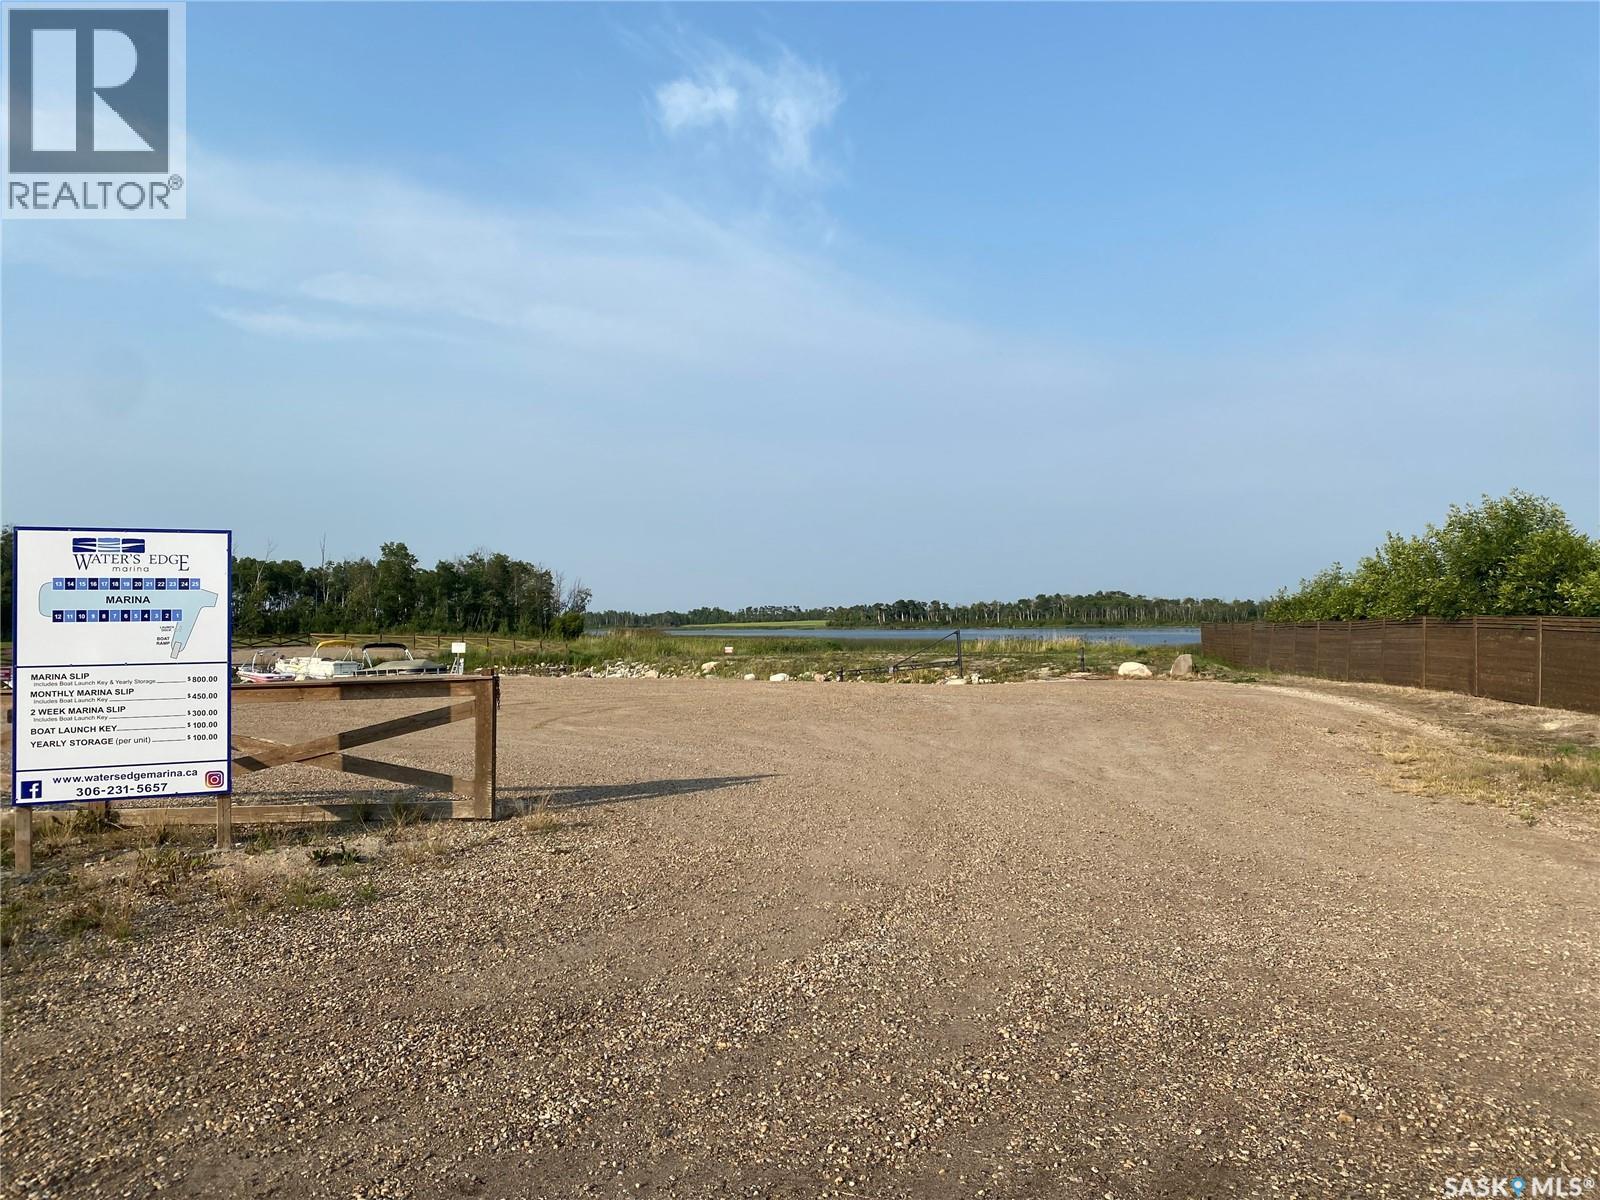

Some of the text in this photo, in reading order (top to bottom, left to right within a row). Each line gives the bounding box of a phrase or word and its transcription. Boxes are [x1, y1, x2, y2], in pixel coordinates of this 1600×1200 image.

[73, 554, 190, 572] WATER'S EDGE
[106, 596, 150, 604] MARINA
[69, 738, 114, 746] STORAGE
[115, 737, 132, 746] (per
[134, 736, 151, 744] unit)
[53, 769, 198, 784] www.watersedgemarina.ca
[76, 783, 168, 796] 306-231-5657
